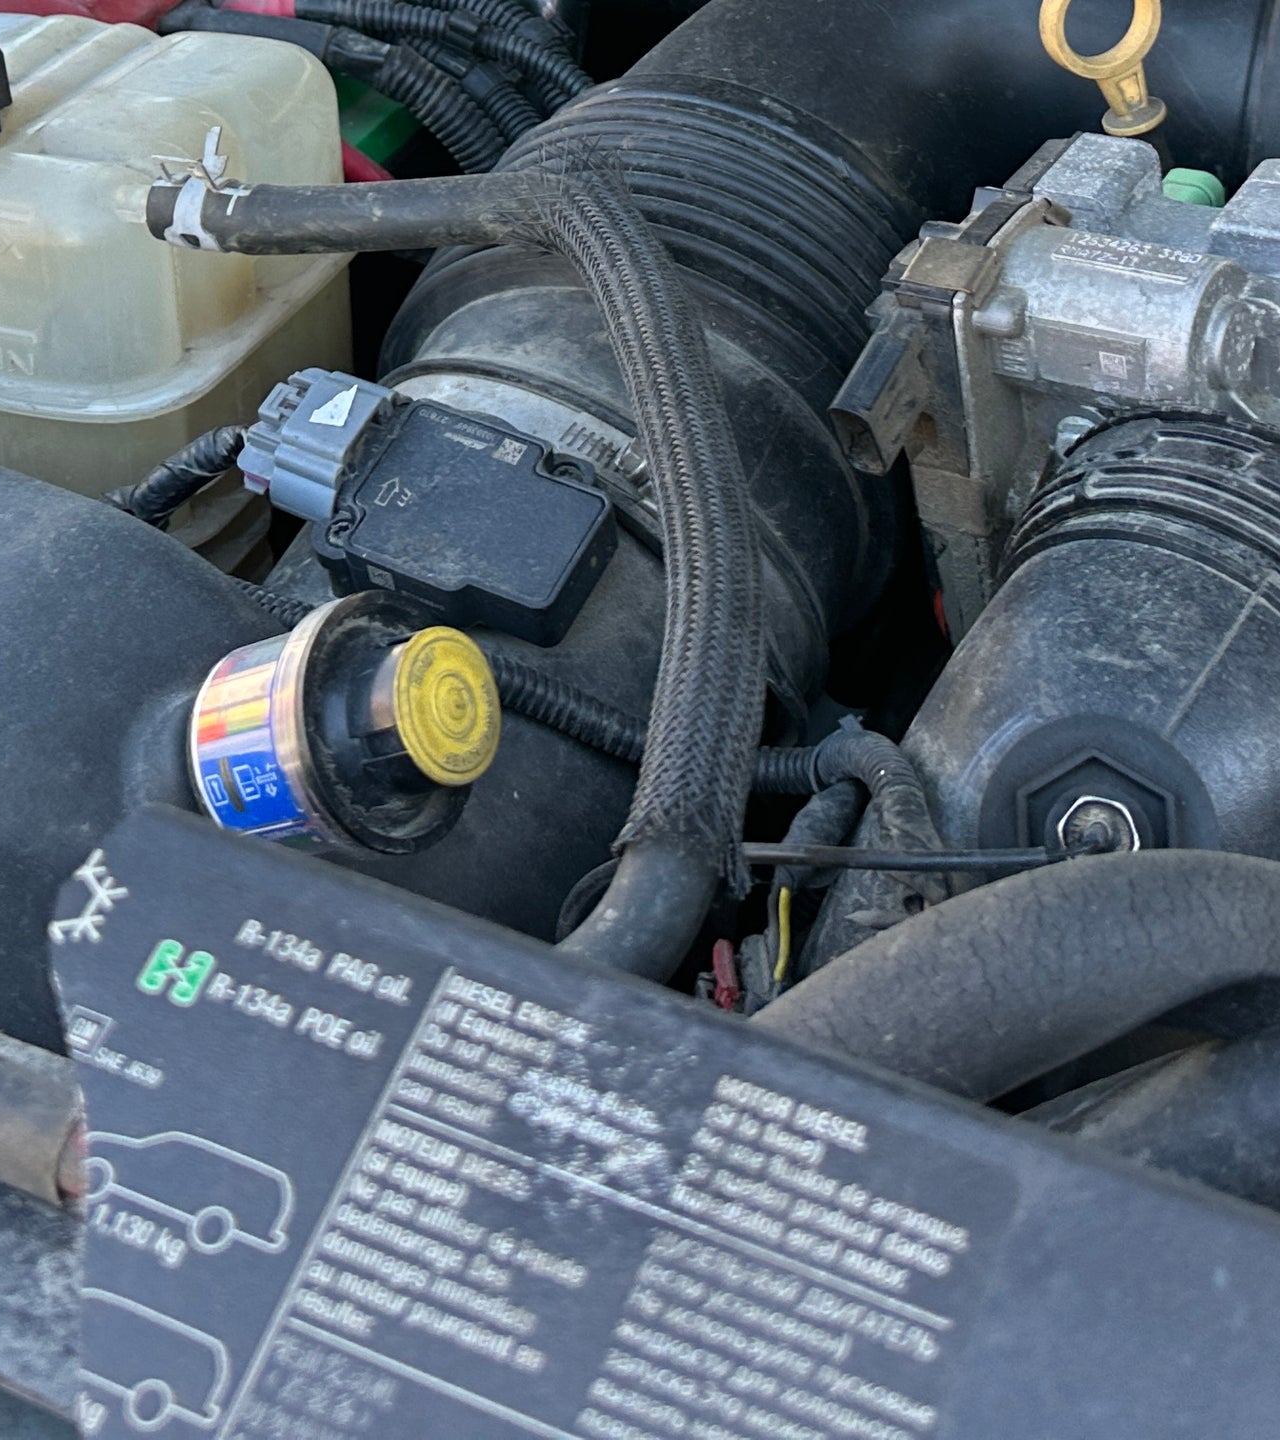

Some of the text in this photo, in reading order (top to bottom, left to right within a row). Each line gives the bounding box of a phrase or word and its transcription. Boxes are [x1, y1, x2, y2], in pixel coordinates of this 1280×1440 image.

[235, 918, 323, 972] R-134a
[326, 952, 380, 993] PAG
[205, 971, 384, 1060] R-134a POE oil
[444, 972, 518, 1017] DIESEL
[95, 1047, 128, 1072] SAE
[421, 1022, 453, 1050] Do
[449, 1034, 487, 1064] not
[712, 1071, 796, 1122] MOTOR
[790, 1101, 874, 1153] DIESEL
[372, 1117, 461, 1169] MOTEUR
[376, 1186, 419, 1220] pas
[94, 1203, 187, 1268] 1.130 kg
[317, 1227, 434, 1294] dommages
[305, 1259, 337, 1285] au
[334, 1268, 412, 1316] moteur
